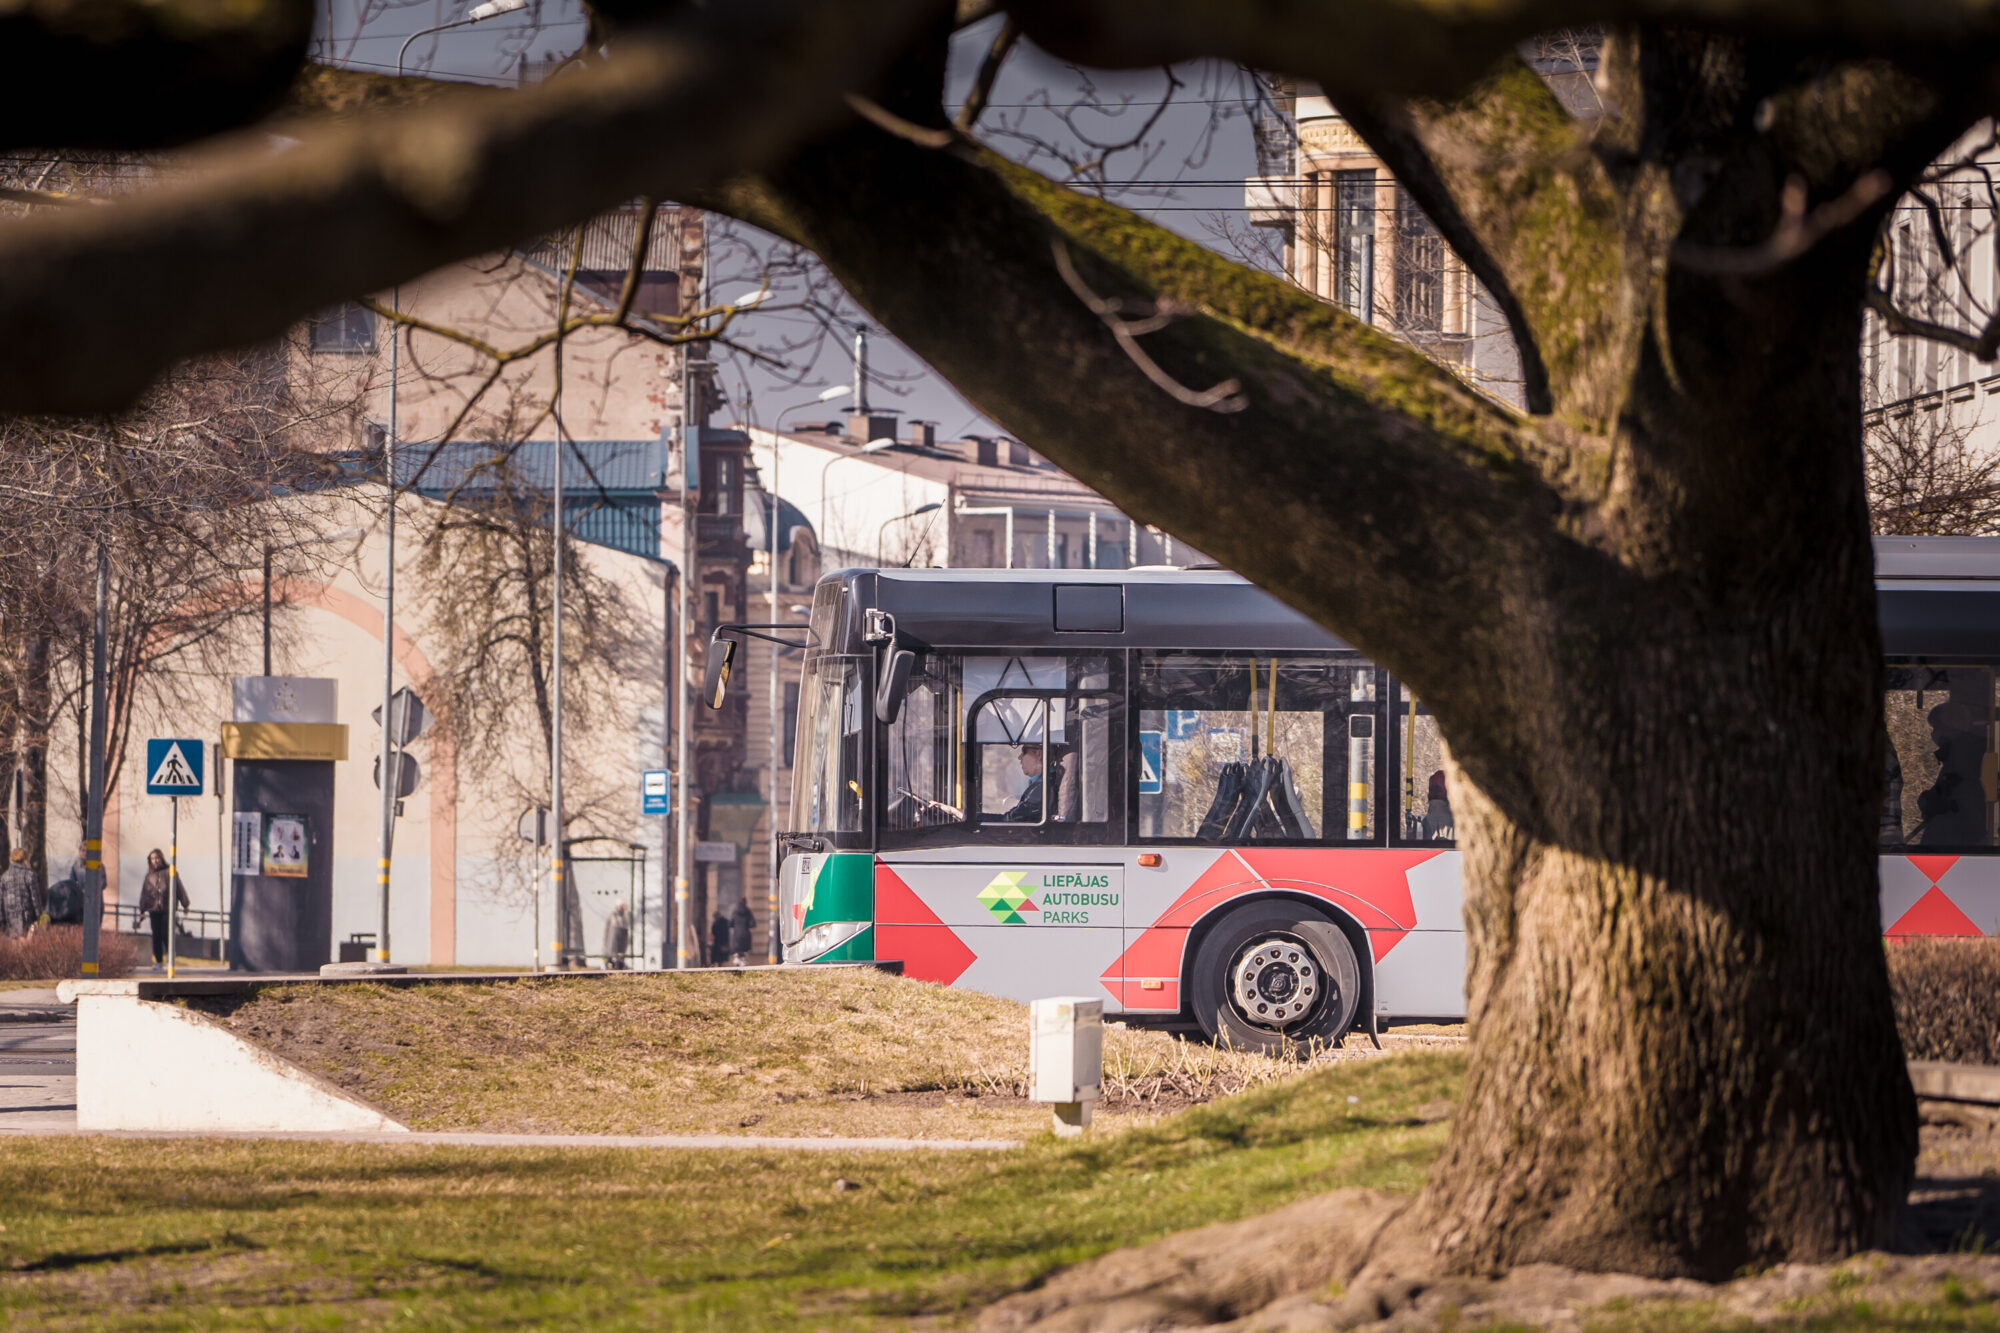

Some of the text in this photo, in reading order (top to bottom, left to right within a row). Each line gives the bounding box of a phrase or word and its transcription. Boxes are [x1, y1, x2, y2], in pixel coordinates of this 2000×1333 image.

[1043, 872, 1109, 888] LIEPĀJAS
[1042, 893, 1119, 906] AUTOBUSU
[1043, 911, 1089, 924] PARKS
